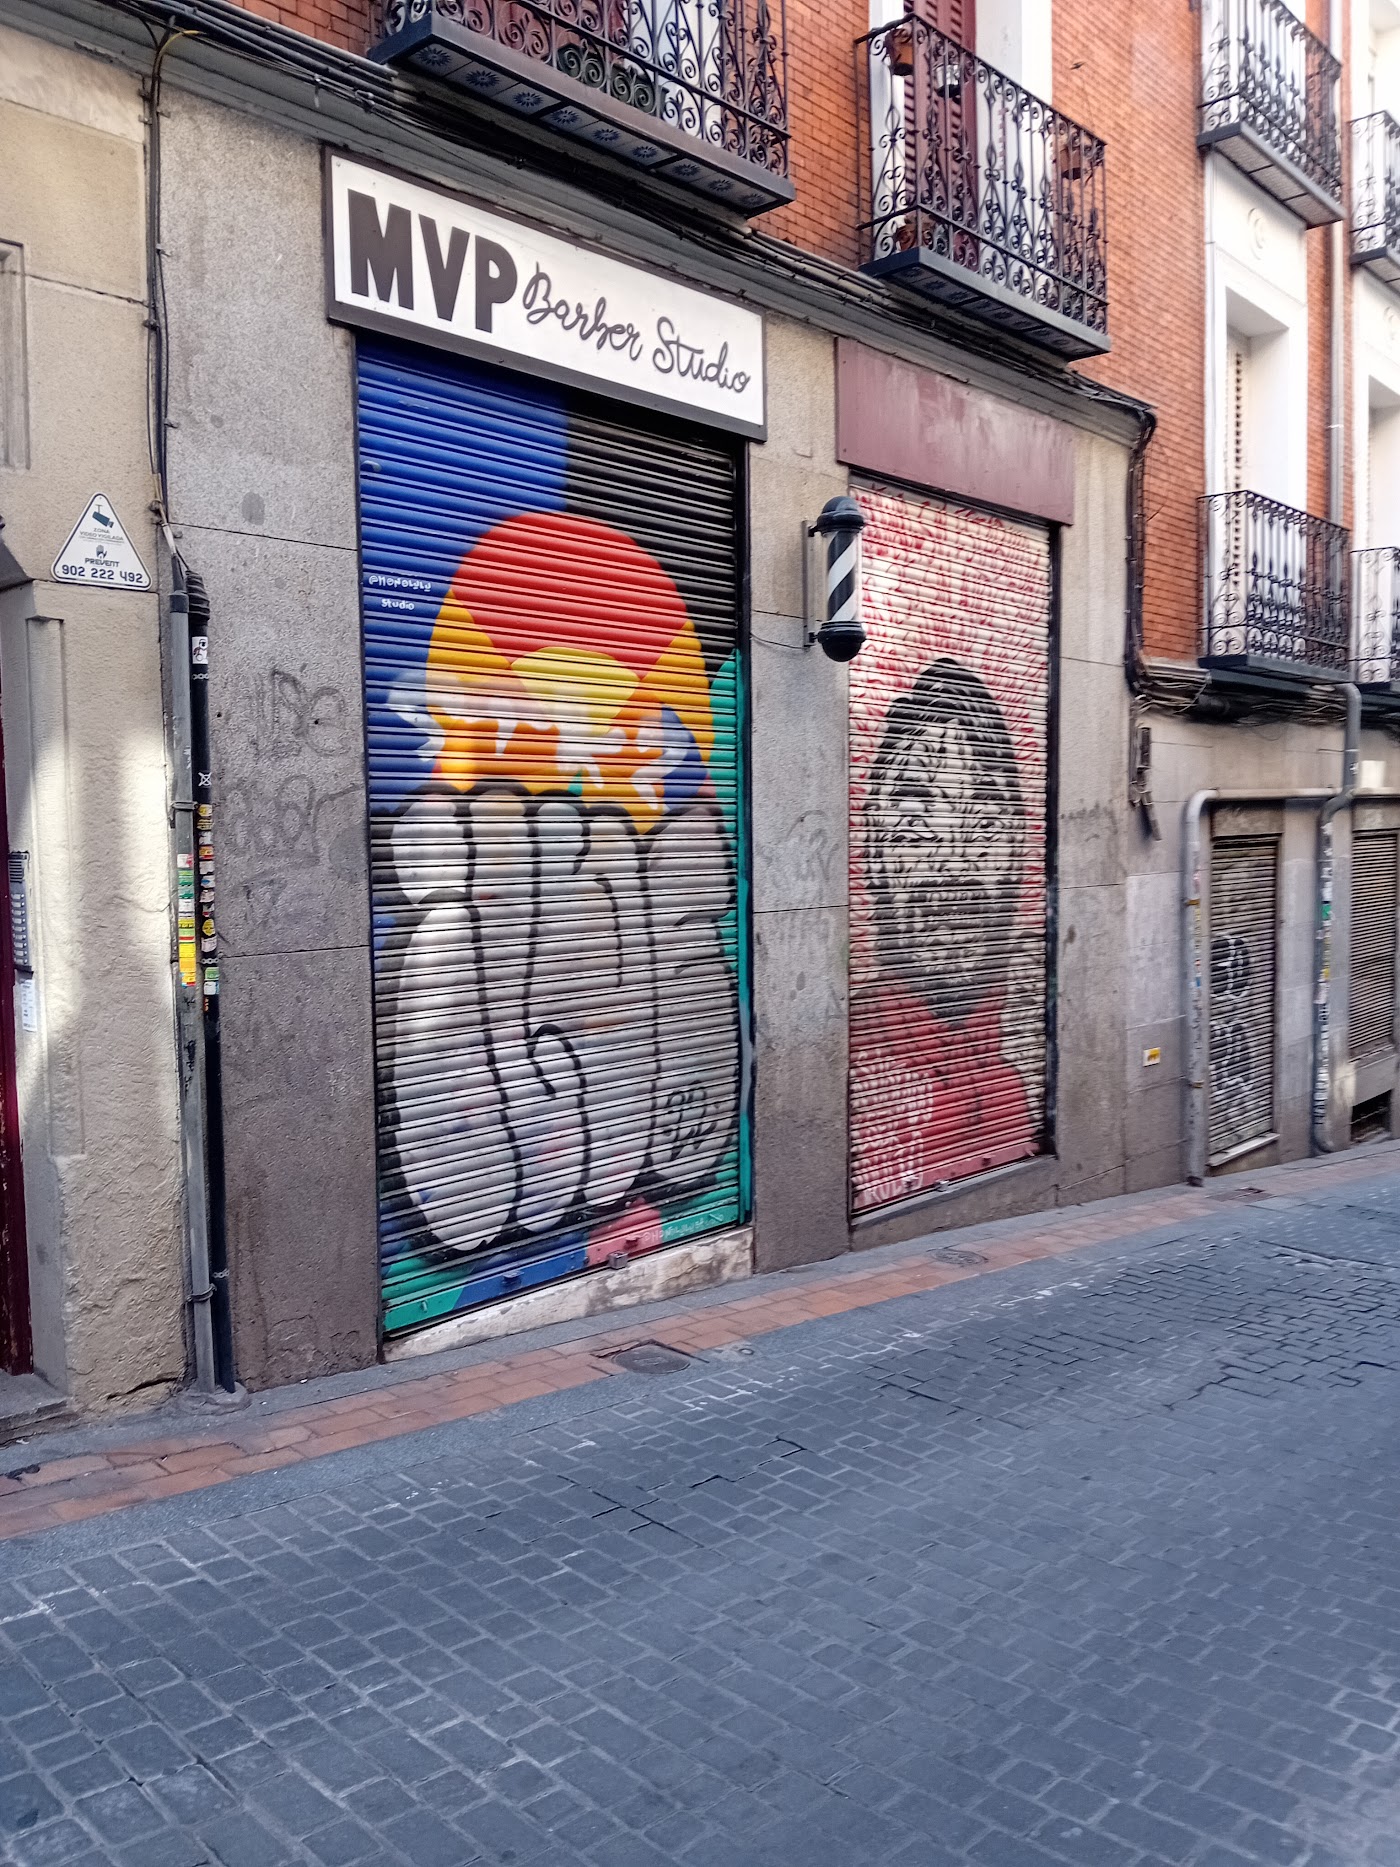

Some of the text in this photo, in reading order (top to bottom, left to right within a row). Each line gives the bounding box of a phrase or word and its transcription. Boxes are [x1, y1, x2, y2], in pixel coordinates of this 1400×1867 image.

[346, 187, 751, 395] MVP Barber Studio
[84, 557, 120, 567] PREVENT
[61, 564, 143, 584] 902 222 492
[381, 598, 415, 611] Studio
